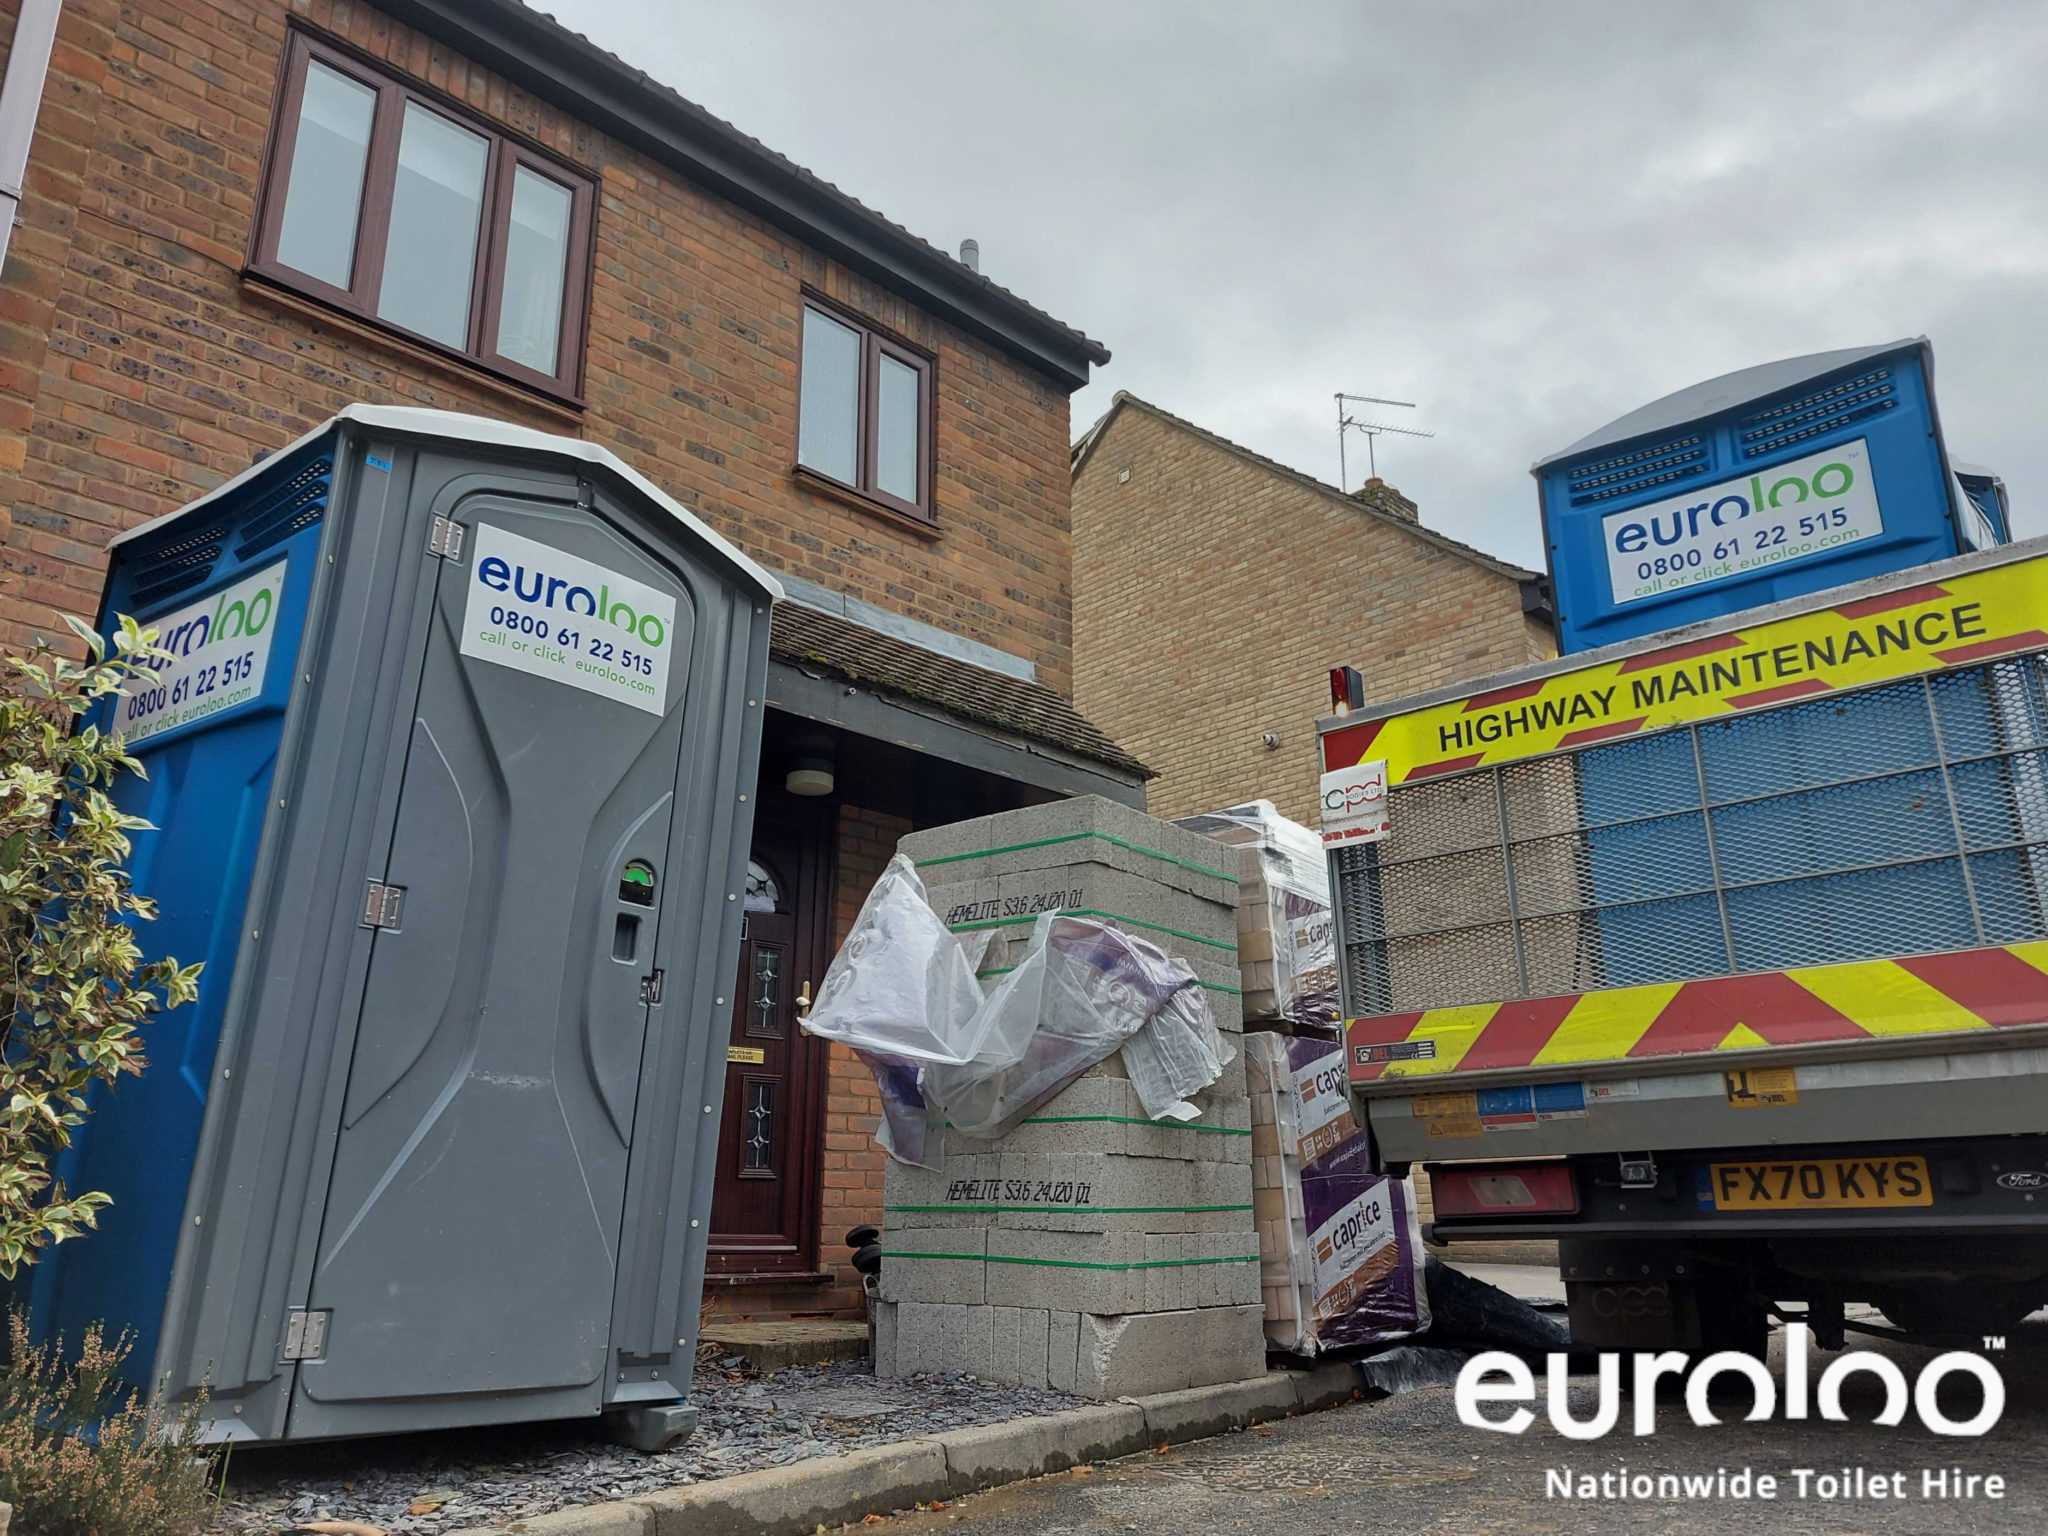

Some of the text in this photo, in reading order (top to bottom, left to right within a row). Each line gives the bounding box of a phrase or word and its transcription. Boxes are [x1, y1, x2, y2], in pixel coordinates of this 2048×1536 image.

[1615, 463, 1854, 553] euroloo
[1634, 528, 1859, 597] call or click euroloo.com
[1638, 507, 1848, 580] 0800 61 22 515
[478, 556, 664, 647] euroloo
[480, 630, 655, 696] call or click euroloo.com
[490, 606, 653, 676] 0800 61 22 515
[128, 651, 254, 720] 0800 61 22 515
[1439, 602, 1987, 752] HIGHWAY MAINTENANCE
[141, 723, 153, 736] or
[155, 709, 179, 733] click
[182, 686, 251, 721] euroloo.com
[944, 900, 1001, 925] HEMELITE
[945, 1179, 1003, 1202] HEMELITE
[1719, 1161, 1922, 1201] FX70 KYS
[2009, 1173, 2040, 1186] Ford
[1333, 1201, 1381, 1250] caprice
